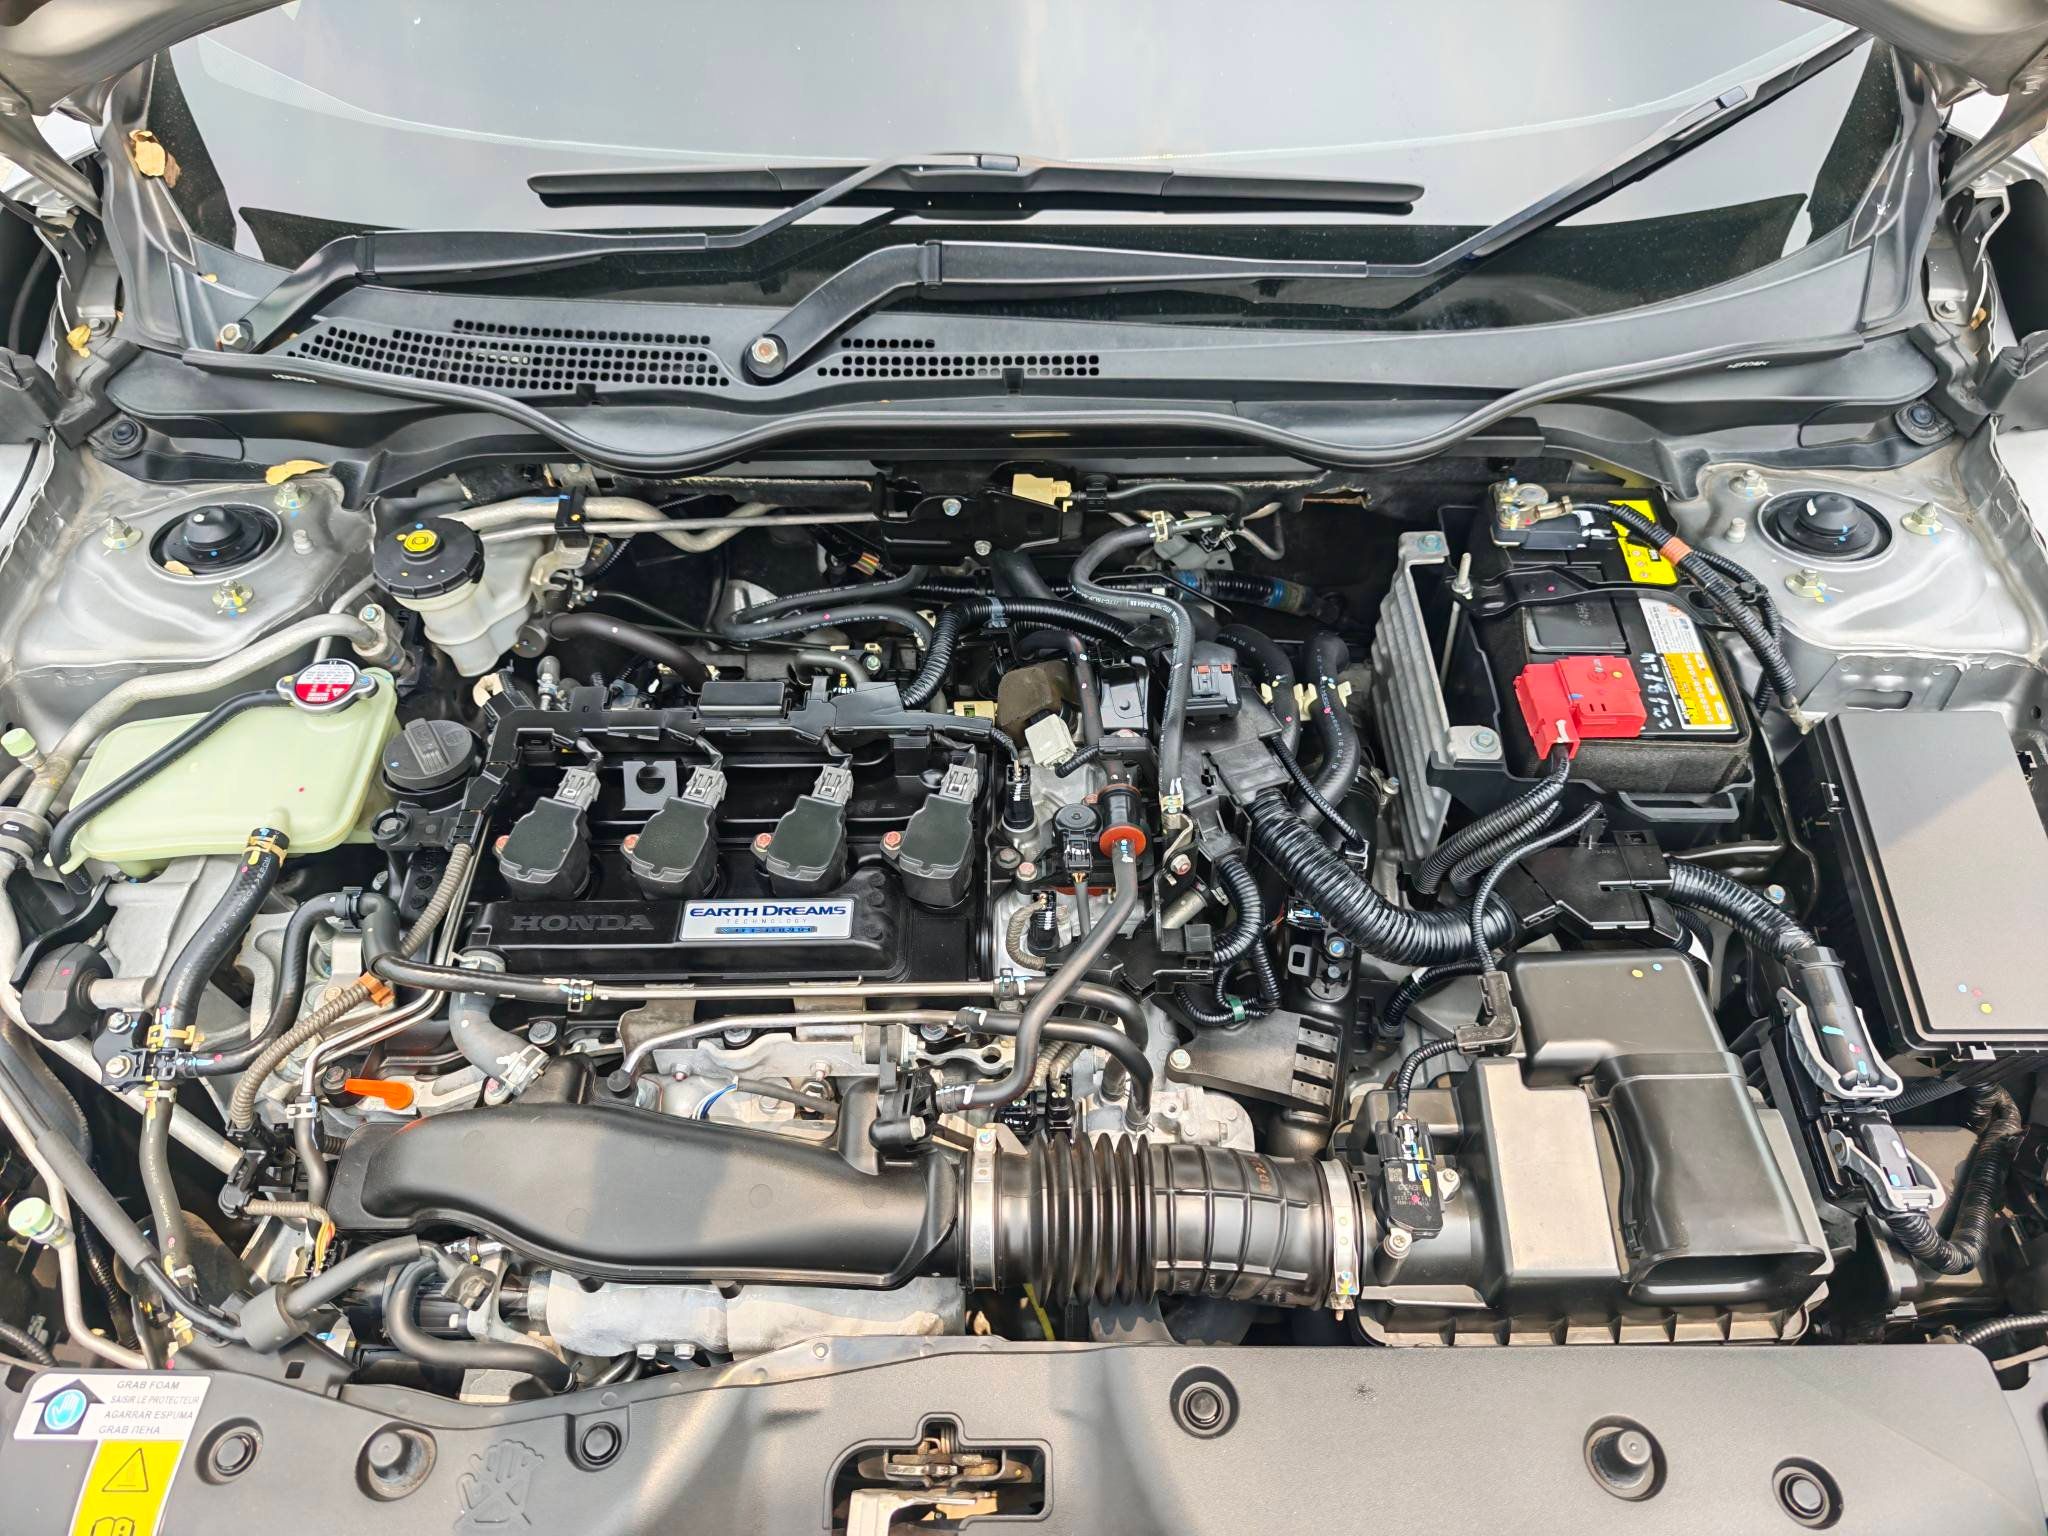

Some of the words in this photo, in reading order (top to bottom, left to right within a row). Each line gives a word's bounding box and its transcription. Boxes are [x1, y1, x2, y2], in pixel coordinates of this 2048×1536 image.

[689, 907, 758, 917] EARTH
[762, 905, 847, 916] DREAMS
[508, 913, 655, 932] HONDA
[117, 1380, 147, 1389] GRAB
[149, 1380, 180, 1389] FOAM
[137, 1395, 148, 1404] LE
[148, 1395, 200, 1404] PROTECTEUR
[104, 1410, 152, 1419] AGARRAR
[154, 1410, 193, 1419] ESPUMA
[98, 1425, 129, 1434] GRAB
